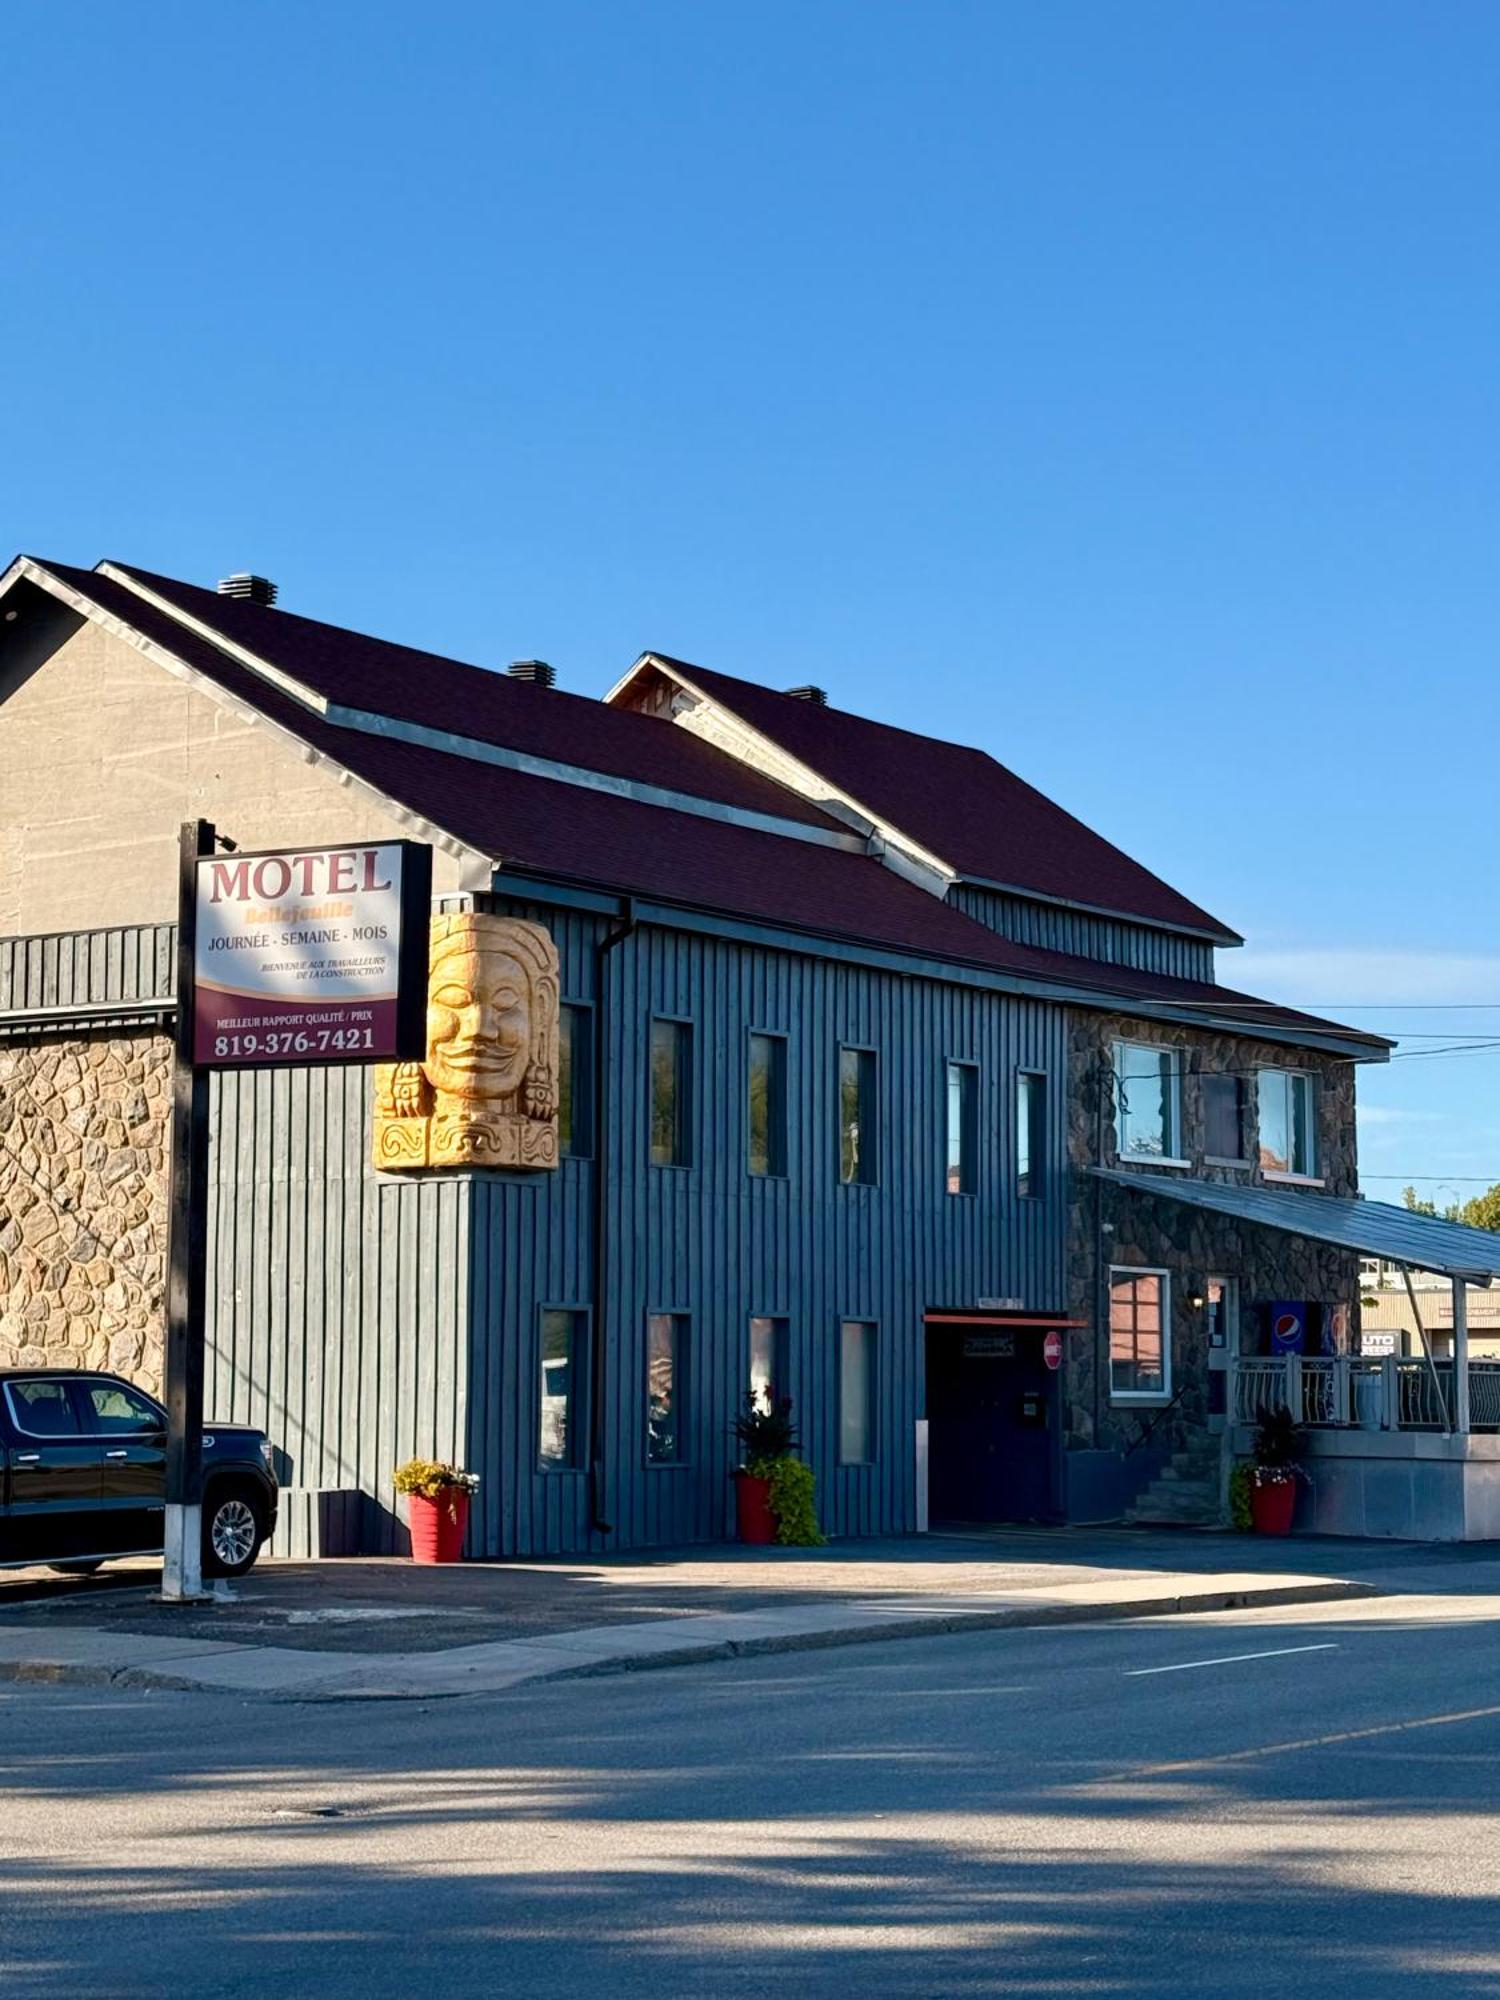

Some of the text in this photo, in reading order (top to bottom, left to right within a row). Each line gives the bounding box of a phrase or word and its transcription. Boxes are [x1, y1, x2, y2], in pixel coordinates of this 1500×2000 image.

[209, 851, 392, 903] MOTEL
[208, 932, 270, 951] JOURNÉE
[281, 929, 340, 946] SEMAINE
[352, 926, 388, 942] MOIS
[261, 957, 387, 972] BIENVENUE AUX TRAVAILLEURS
[320, 966, 385, 979] CONSTRUCTION
[216, 1018, 261, 1030] MEILLEUR
[262, 1014, 304, 1027] RAPPORT
[305, 1010, 344, 1024] QUALITÉ
[351, 1010, 374, 1022] PRIX
[214, 1028, 375, 1057] 819-376-7421
[1361, 1335, 1394, 1345] UTO
